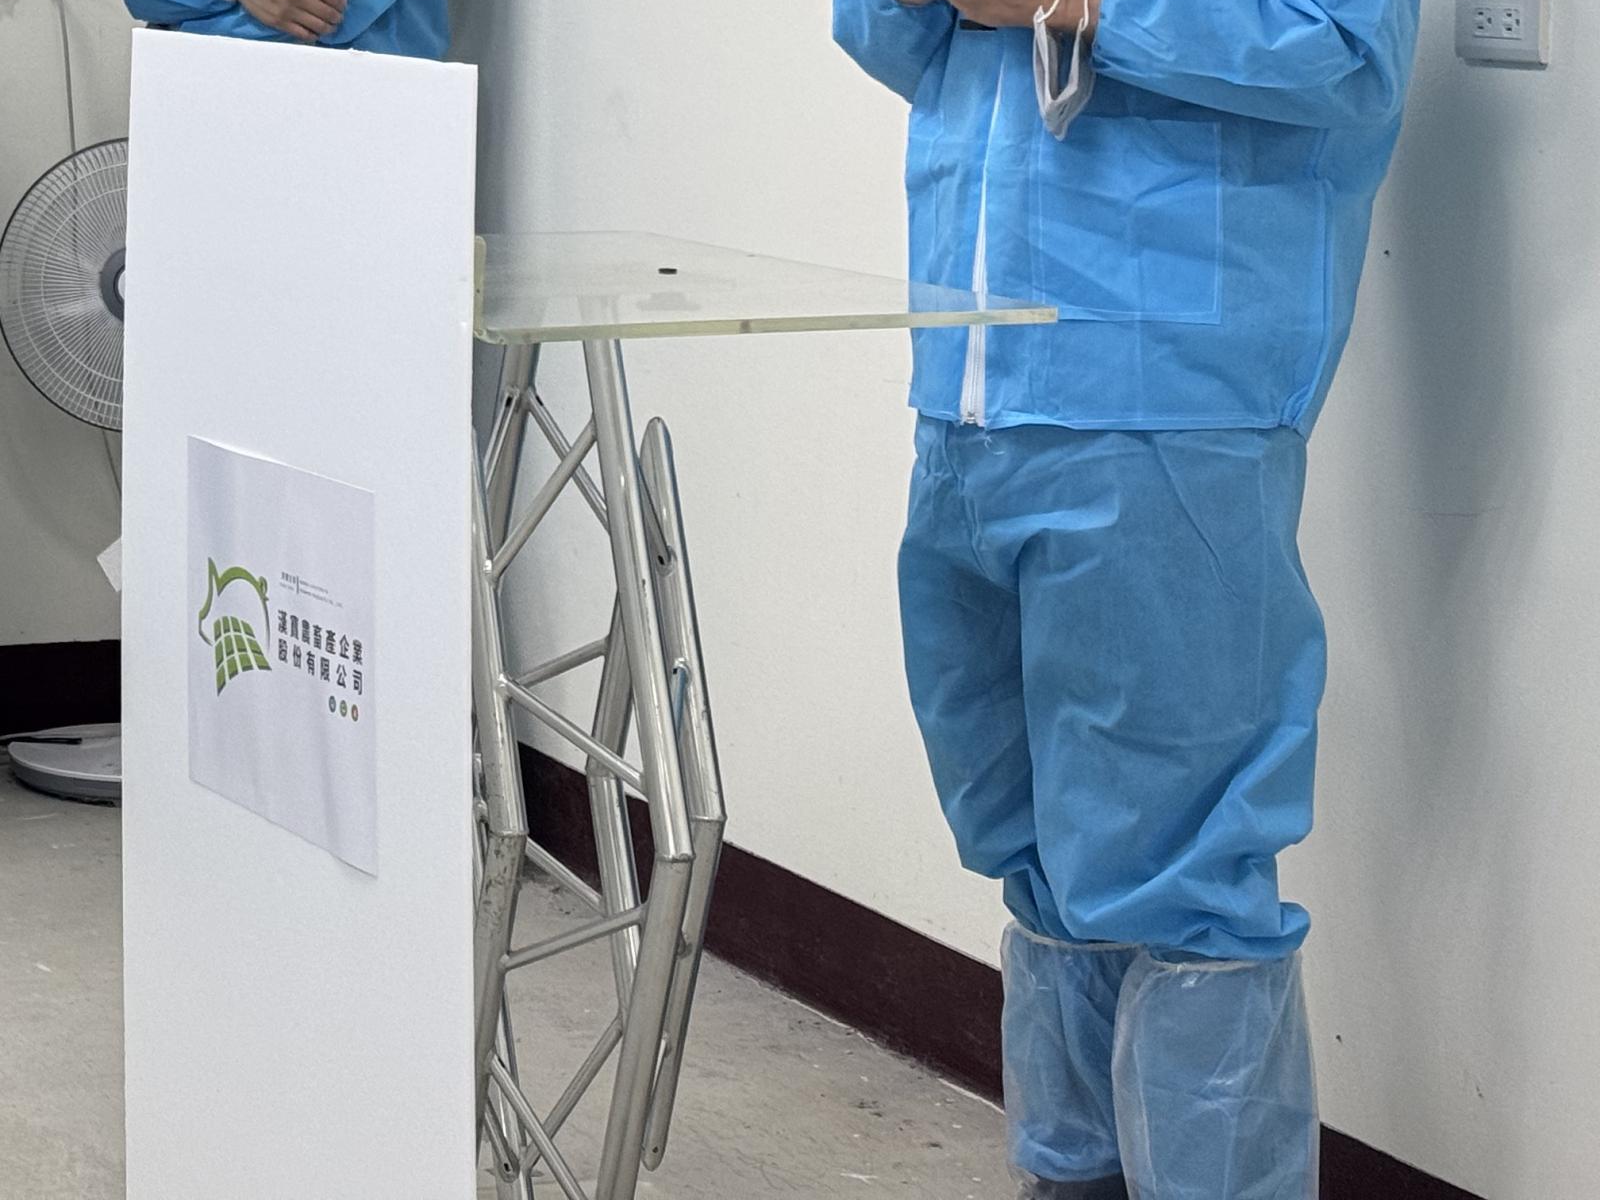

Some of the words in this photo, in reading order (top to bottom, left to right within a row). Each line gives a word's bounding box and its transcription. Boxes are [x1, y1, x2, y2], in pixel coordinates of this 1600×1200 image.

[277, 638, 363, 696] 股份有限公司
